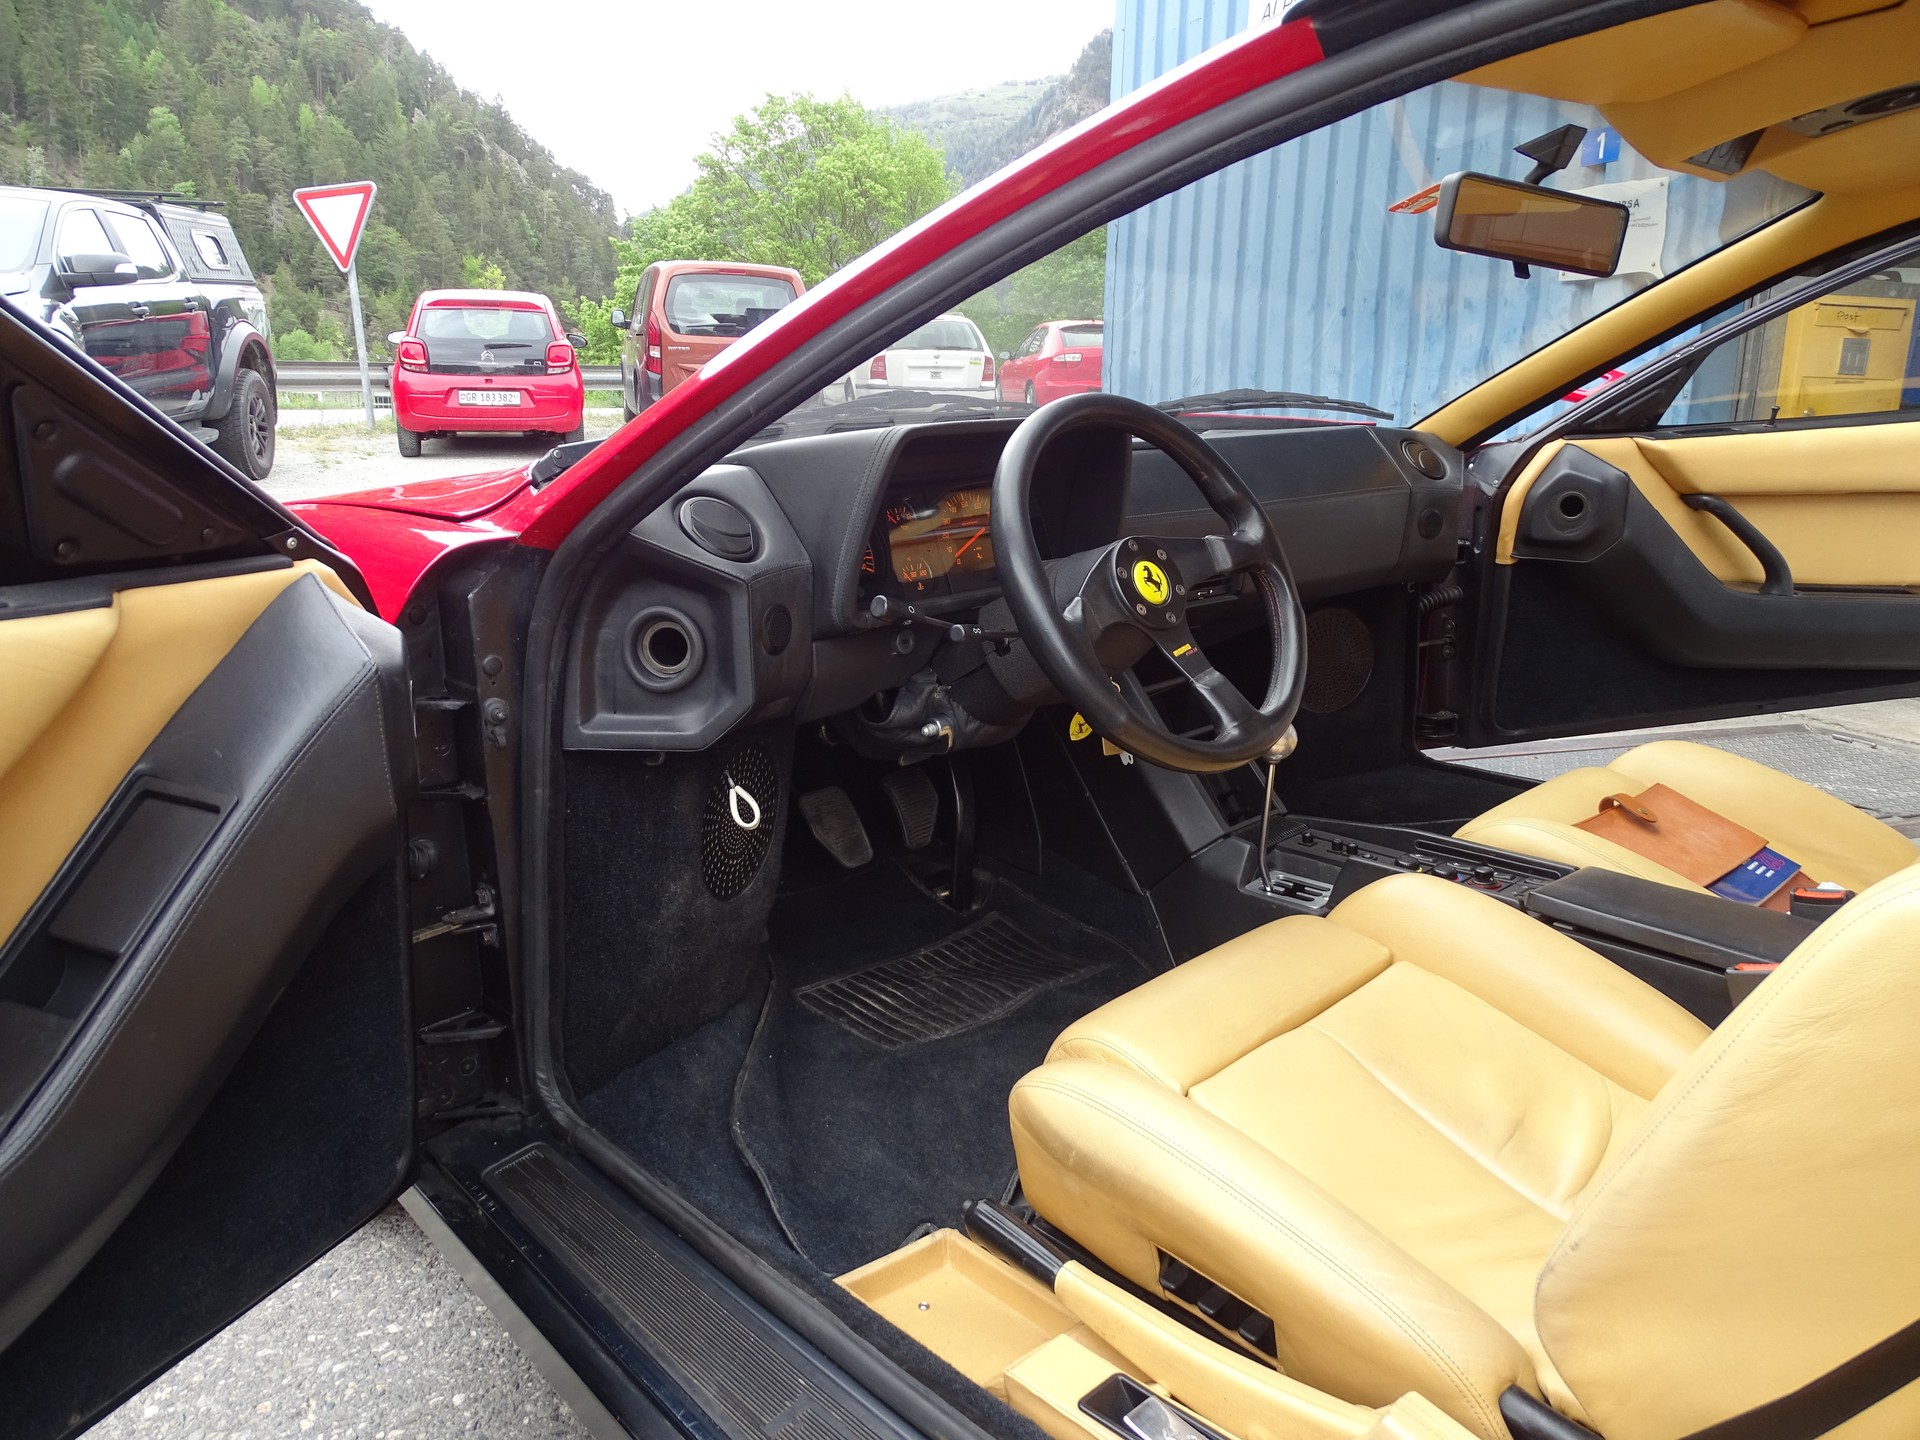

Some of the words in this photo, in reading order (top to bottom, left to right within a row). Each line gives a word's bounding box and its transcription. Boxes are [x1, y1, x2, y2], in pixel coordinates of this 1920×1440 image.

[1597, 132, 1606, 160] 1
[1837, 310, 1861, 323] Post
[466, 392, 477, 402] GR
